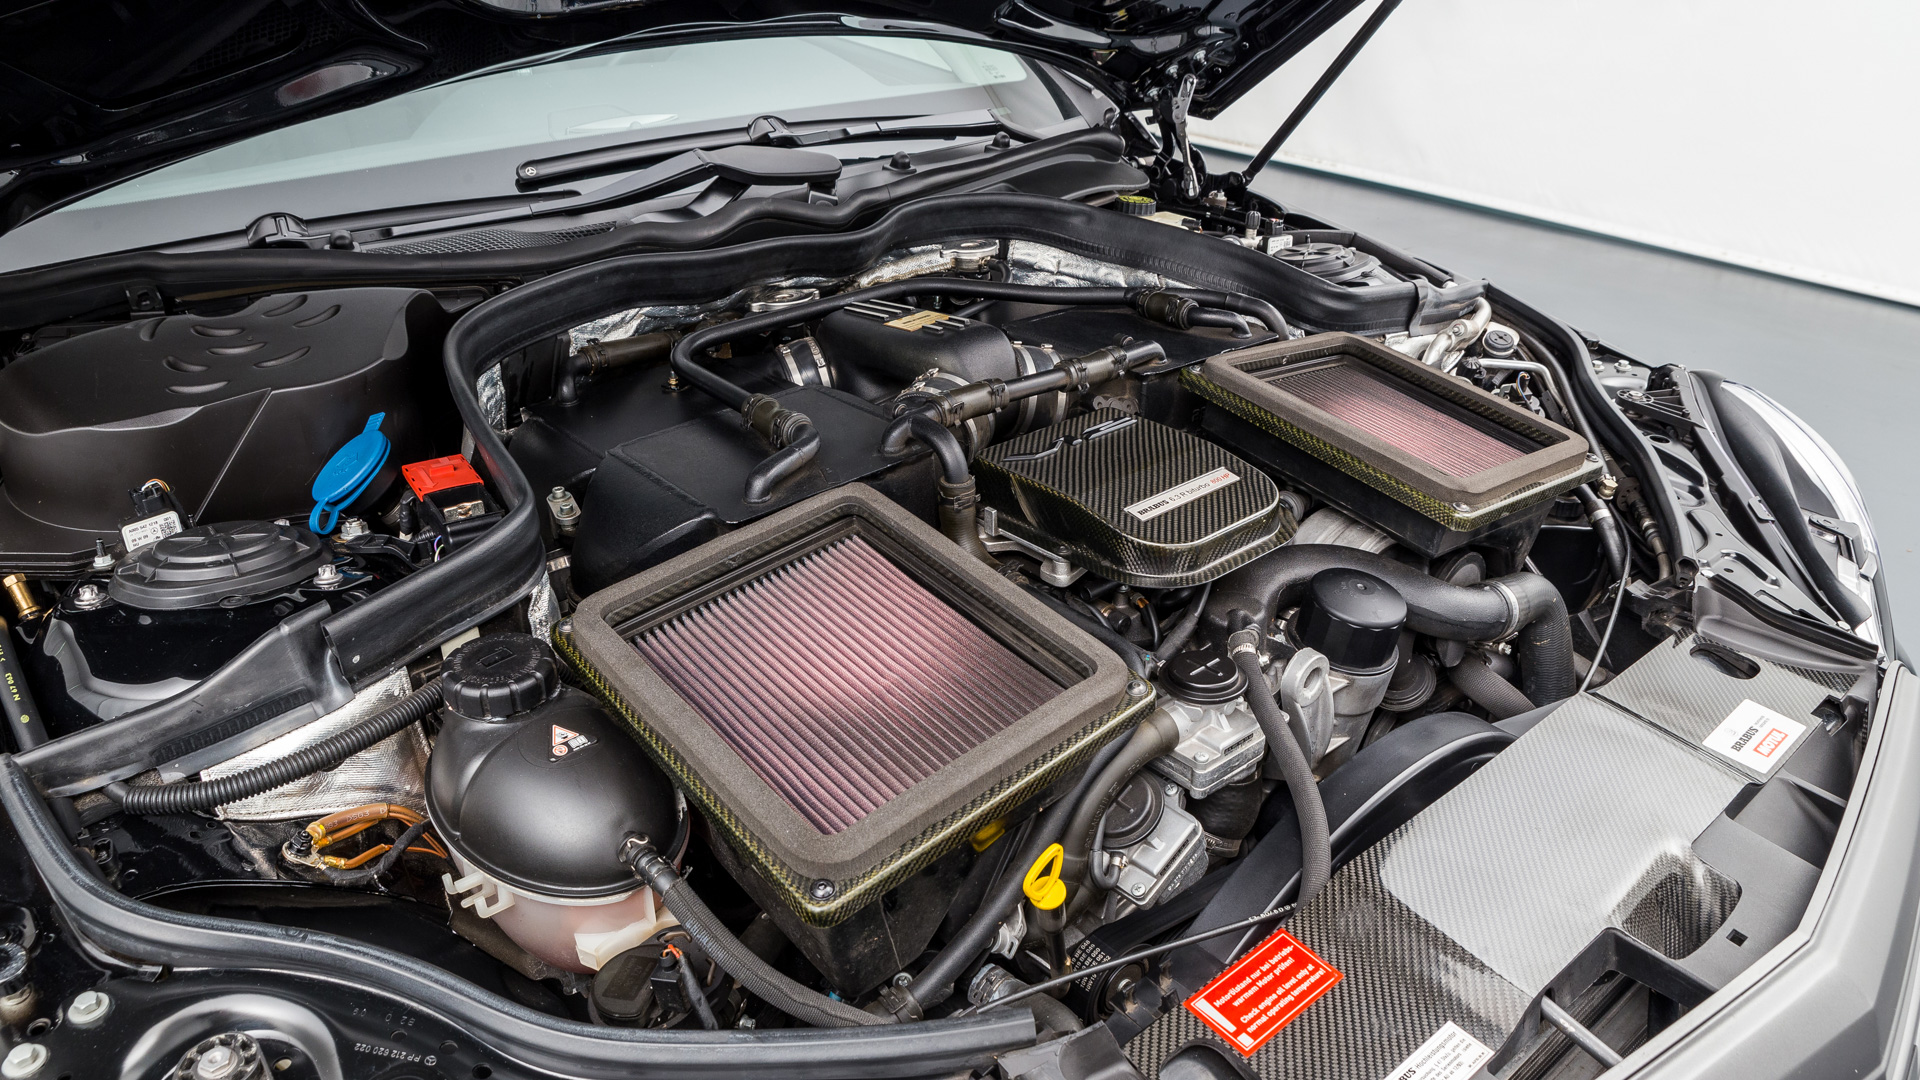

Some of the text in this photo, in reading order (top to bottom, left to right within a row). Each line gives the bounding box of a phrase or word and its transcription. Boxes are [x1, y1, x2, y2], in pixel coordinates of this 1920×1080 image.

[1137, 499, 1170, 516] BRABUS
[1186, 482, 1211, 495] biturbo
[1220, 472, 1230, 480] HP
[9, 685, 18, 693] 67
[12, 693, 21, 702] N
[1730, 726, 1759, 752] BRABUS
[1756, 731, 1786, 756] MOTUL
[1213, 945, 1294, 1008] Motorölstand nur bei betriebs-
[1232, 956, 1295, 1007] warmem Motor prüfen!
[1240, 963, 1316, 1024] Check engine oil level only at
[1246, 968, 1326, 1034] normal operating temperature!
[354, 1042, 422, 1062] PP 212 620 022
[1416, 1031, 1457, 1069] Hochleistungsmotor
